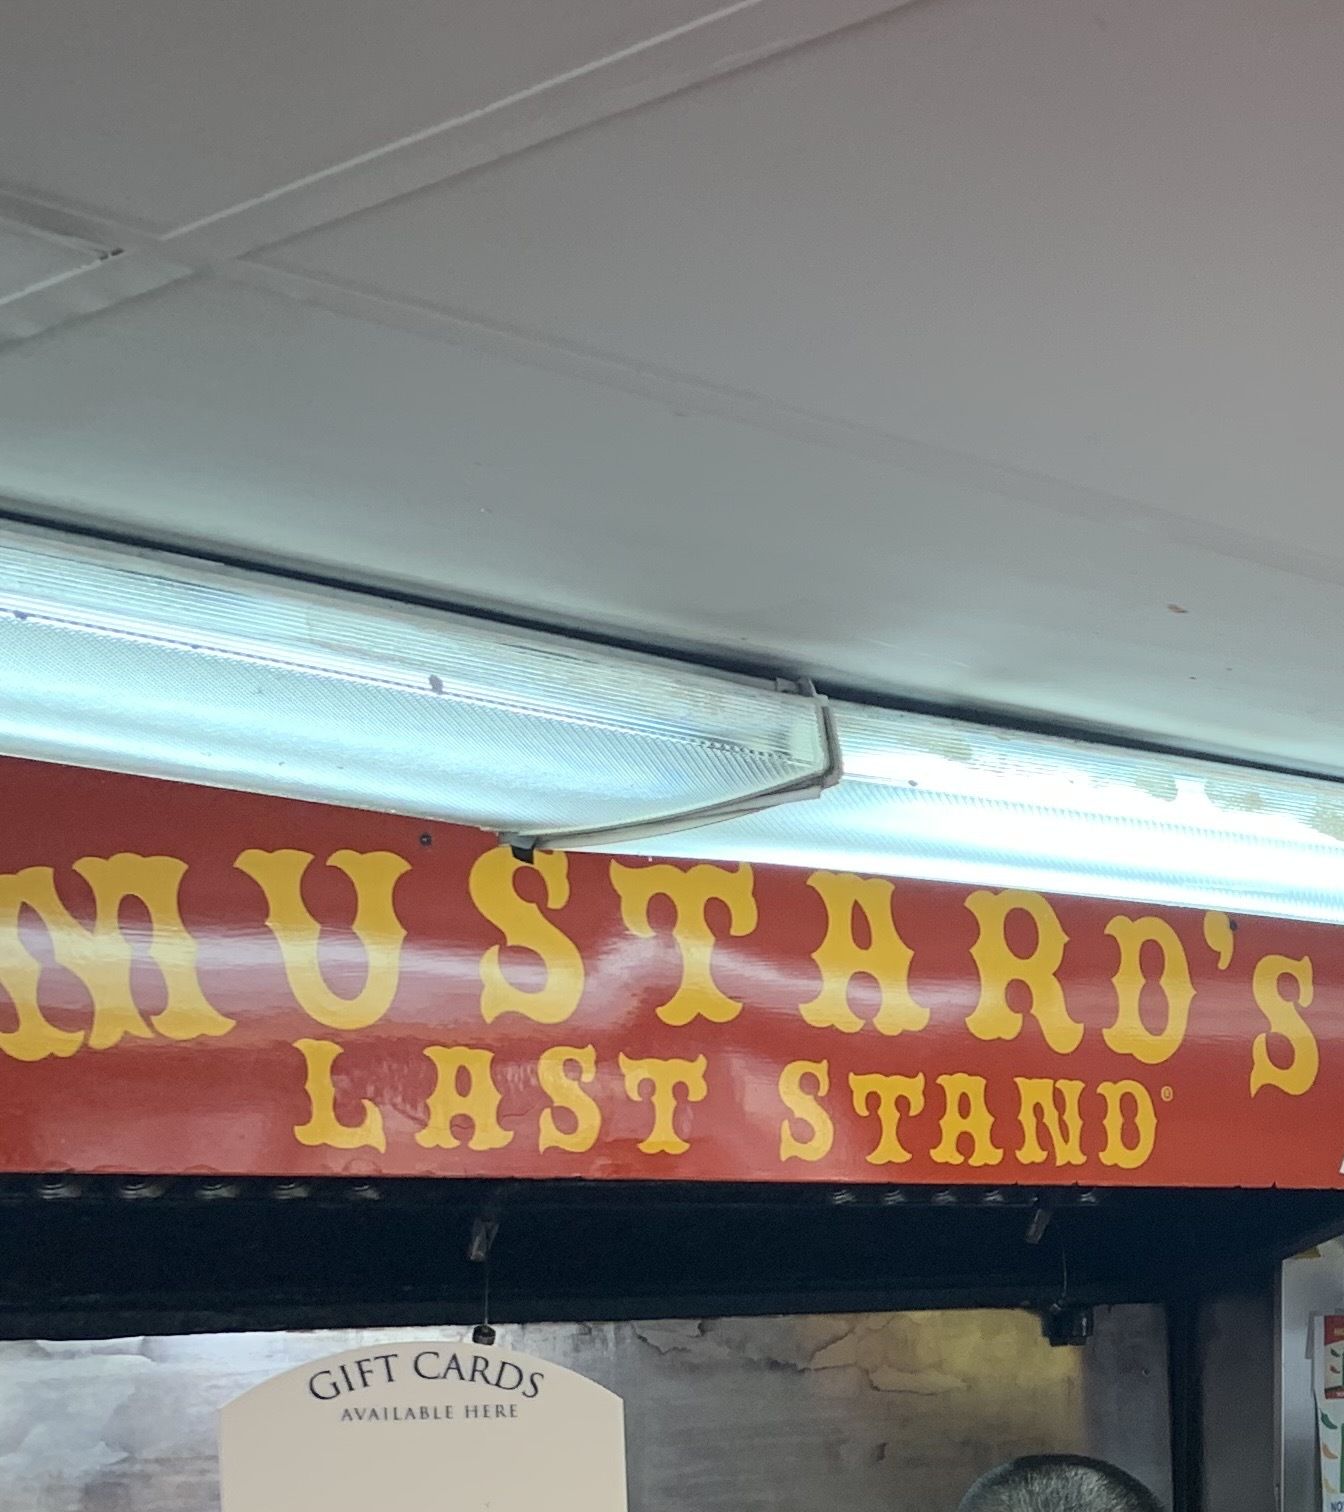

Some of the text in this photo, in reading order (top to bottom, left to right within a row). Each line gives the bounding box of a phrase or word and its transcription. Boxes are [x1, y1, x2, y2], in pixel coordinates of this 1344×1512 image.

[0, 846, 1320, 1098] MUSTARD'S
[293, 1038, 708, 1154] LAST
[308, 1351, 544, 1400] GIFT CARDS
[340, 1403, 518, 1421] AVAILABLE HERE
